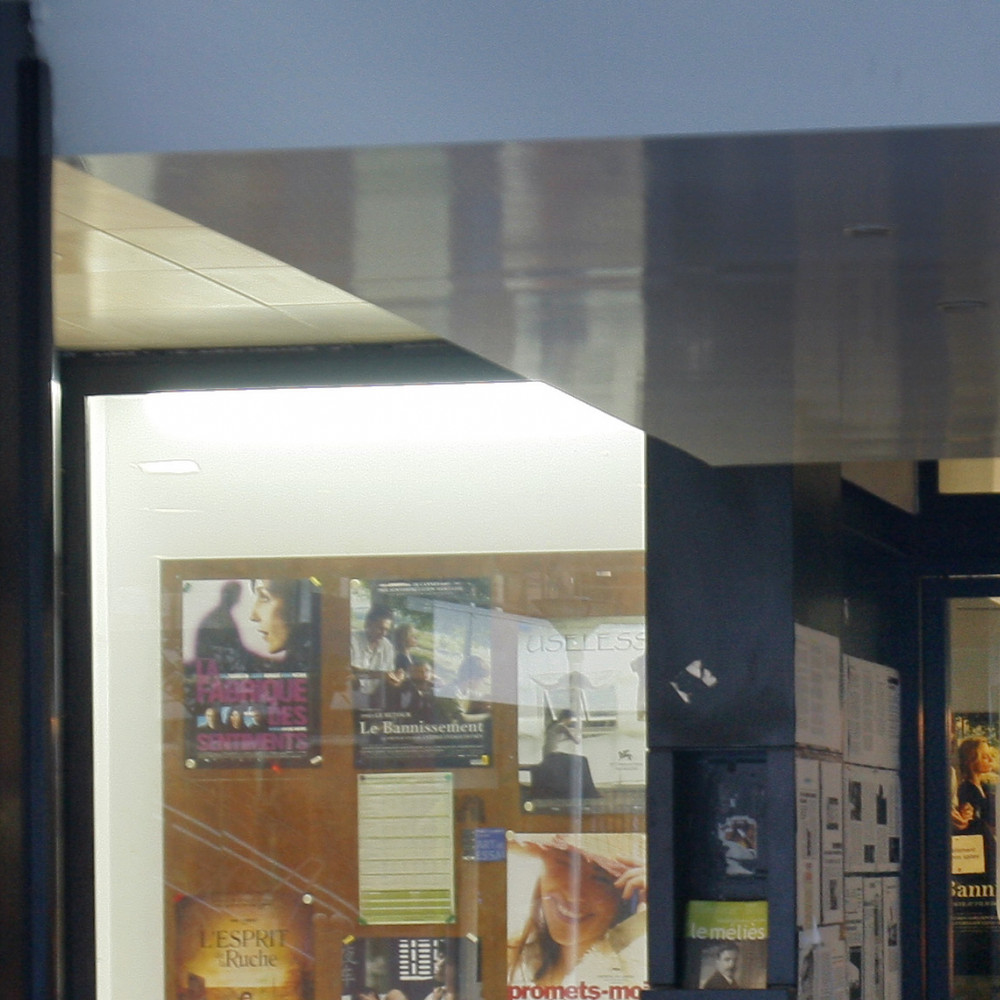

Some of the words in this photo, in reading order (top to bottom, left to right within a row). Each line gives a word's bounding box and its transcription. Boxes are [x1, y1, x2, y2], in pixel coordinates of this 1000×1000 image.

[360, 721, 379, 734] Le
[382, 720, 484, 734] Bannissement
[200, 930, 288, 949] L'ESPRIT
[690, 922, 707, 939] le
[710, 922, 765, 940] méliès
[226, 949, 278, 968] Ruche
